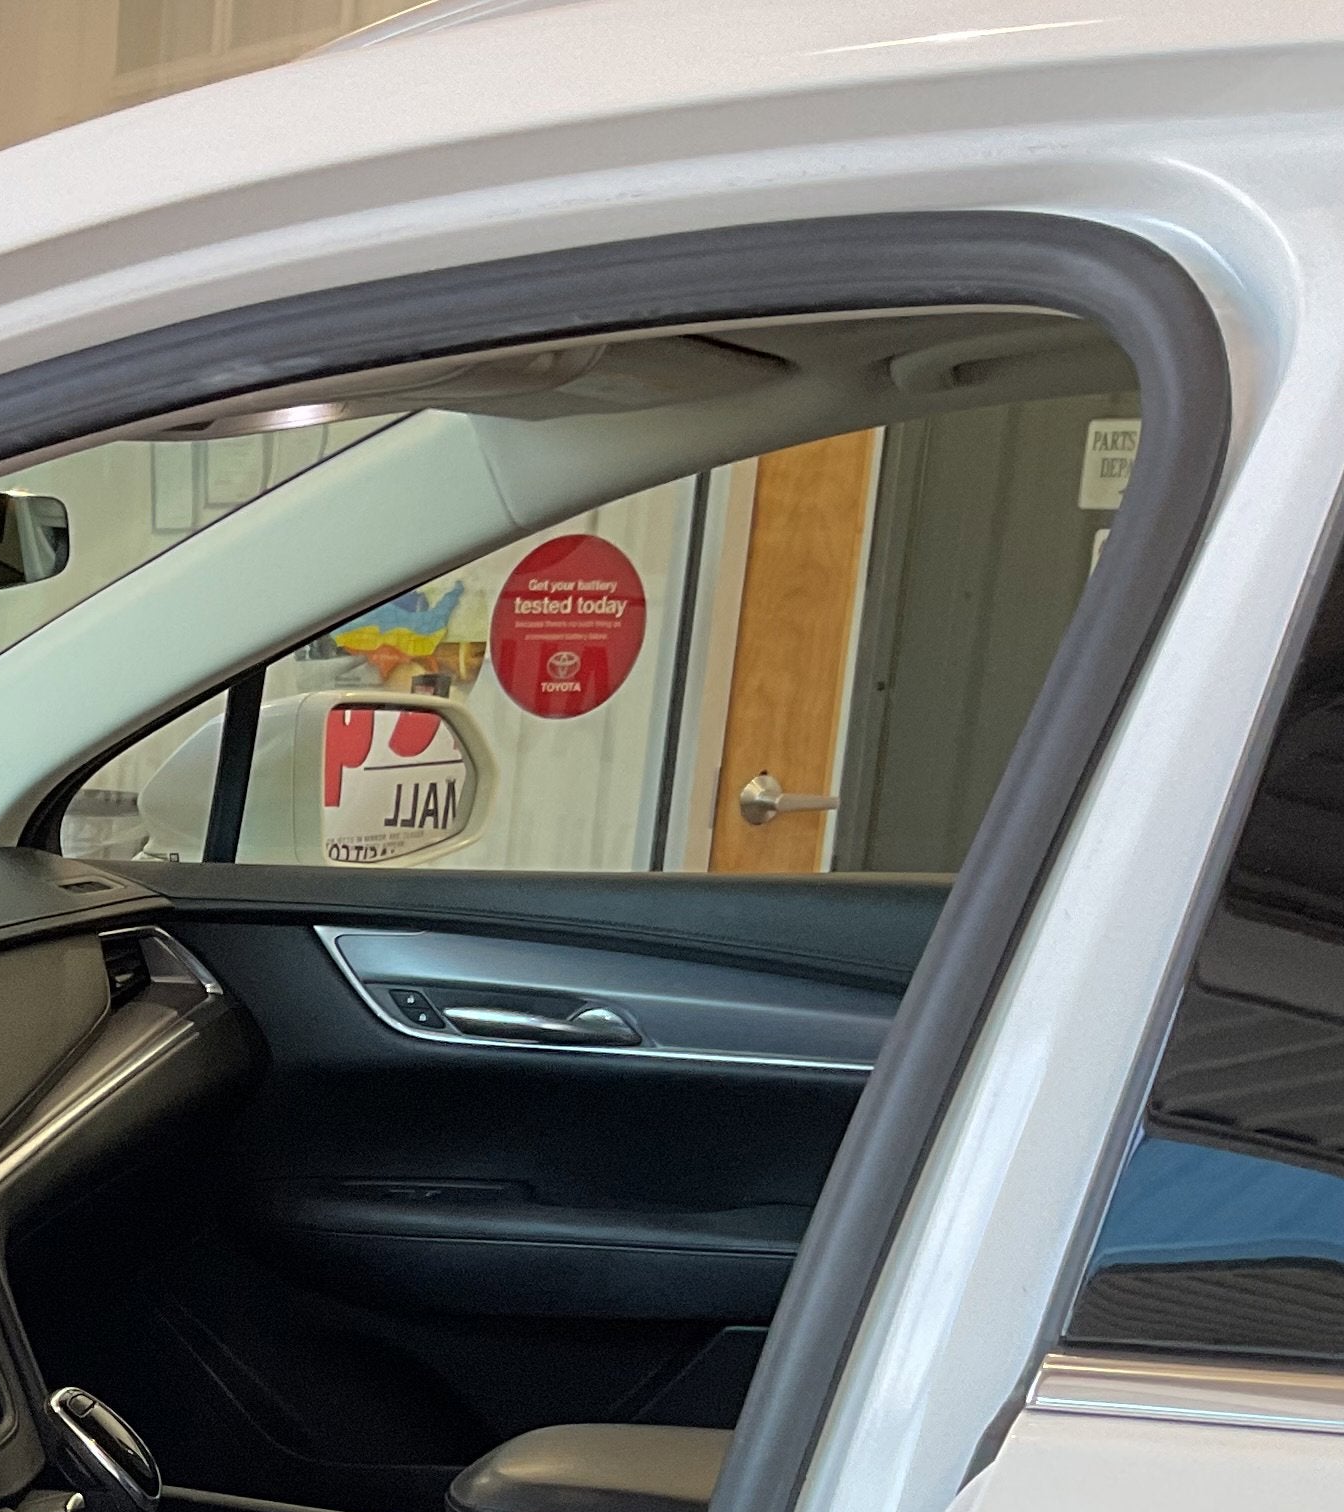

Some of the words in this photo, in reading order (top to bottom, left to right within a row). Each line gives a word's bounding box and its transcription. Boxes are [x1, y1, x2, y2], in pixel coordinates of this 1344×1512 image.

[1092, 431, 1138, 451] PARTS
[1100, 457, 1131, 478] DEP
[528, 579, 549, 591] Get
[550, 581, 575, 593] your
[577, 580, 617, 593] battery
[514, 595, 572, 614] tested
[577, 596, 628, 618] today
[541, 682, 581, 693] TOYOTA
